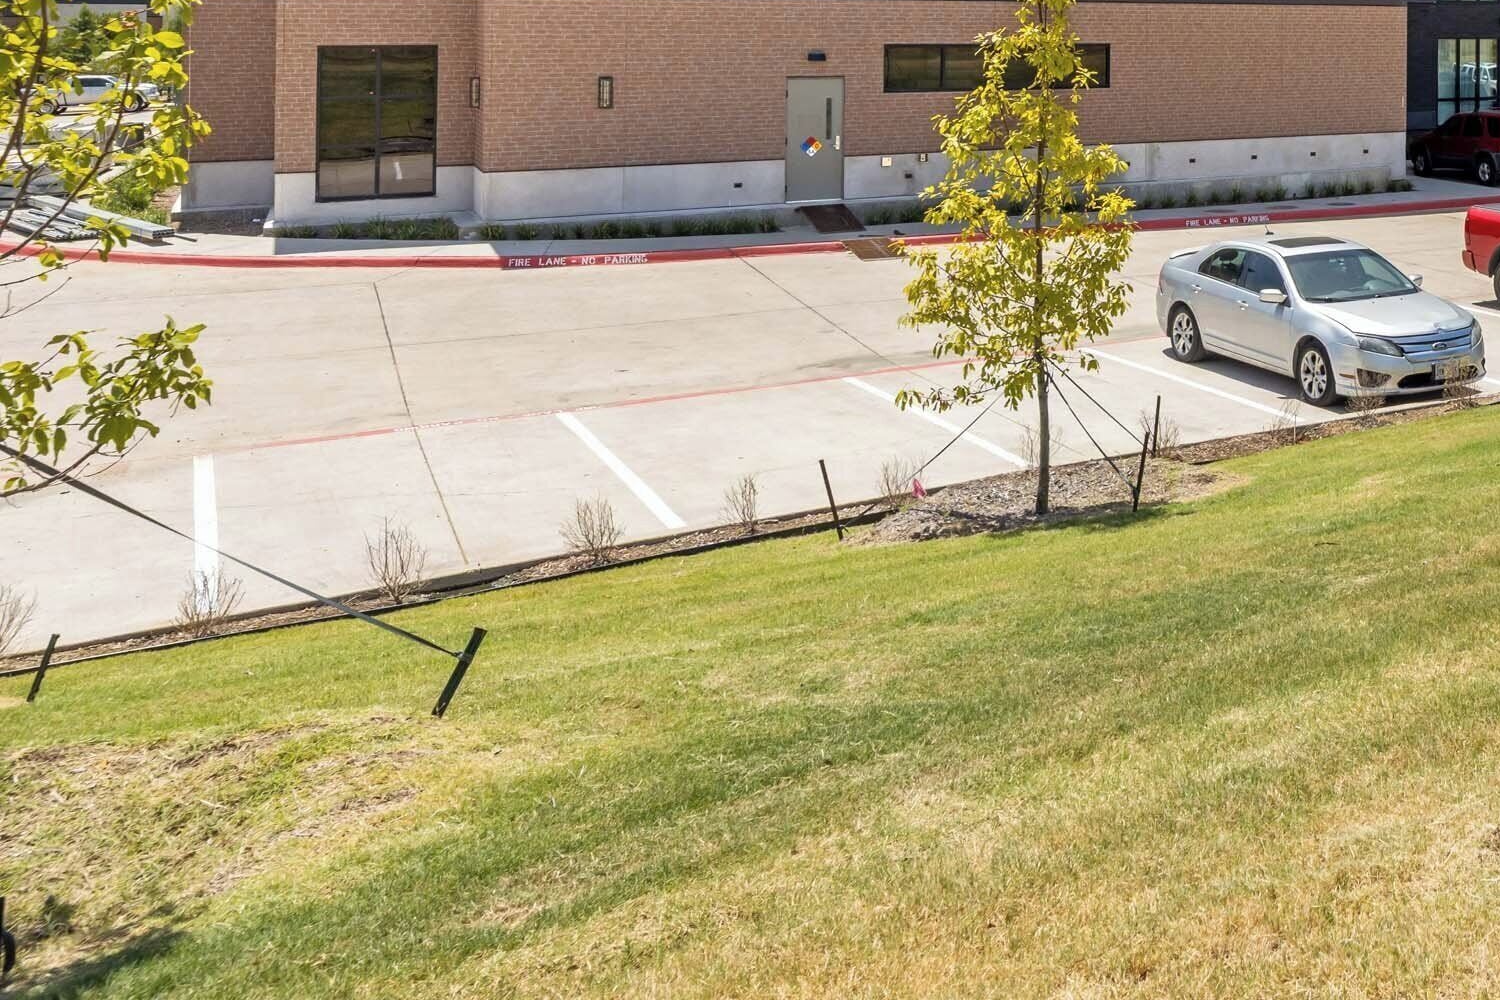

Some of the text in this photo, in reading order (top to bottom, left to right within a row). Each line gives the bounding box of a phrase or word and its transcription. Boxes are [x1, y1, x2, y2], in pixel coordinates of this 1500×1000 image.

[1203, 218, 1222, 226] LANE
[1229, 216, 1239, 224] NO
[508, 257, 531, 267] FIRE
[538, 256, 567, 266] LANE
[581, 255, 596, 265] NO
[604, 254, 648, 265] PARKING
